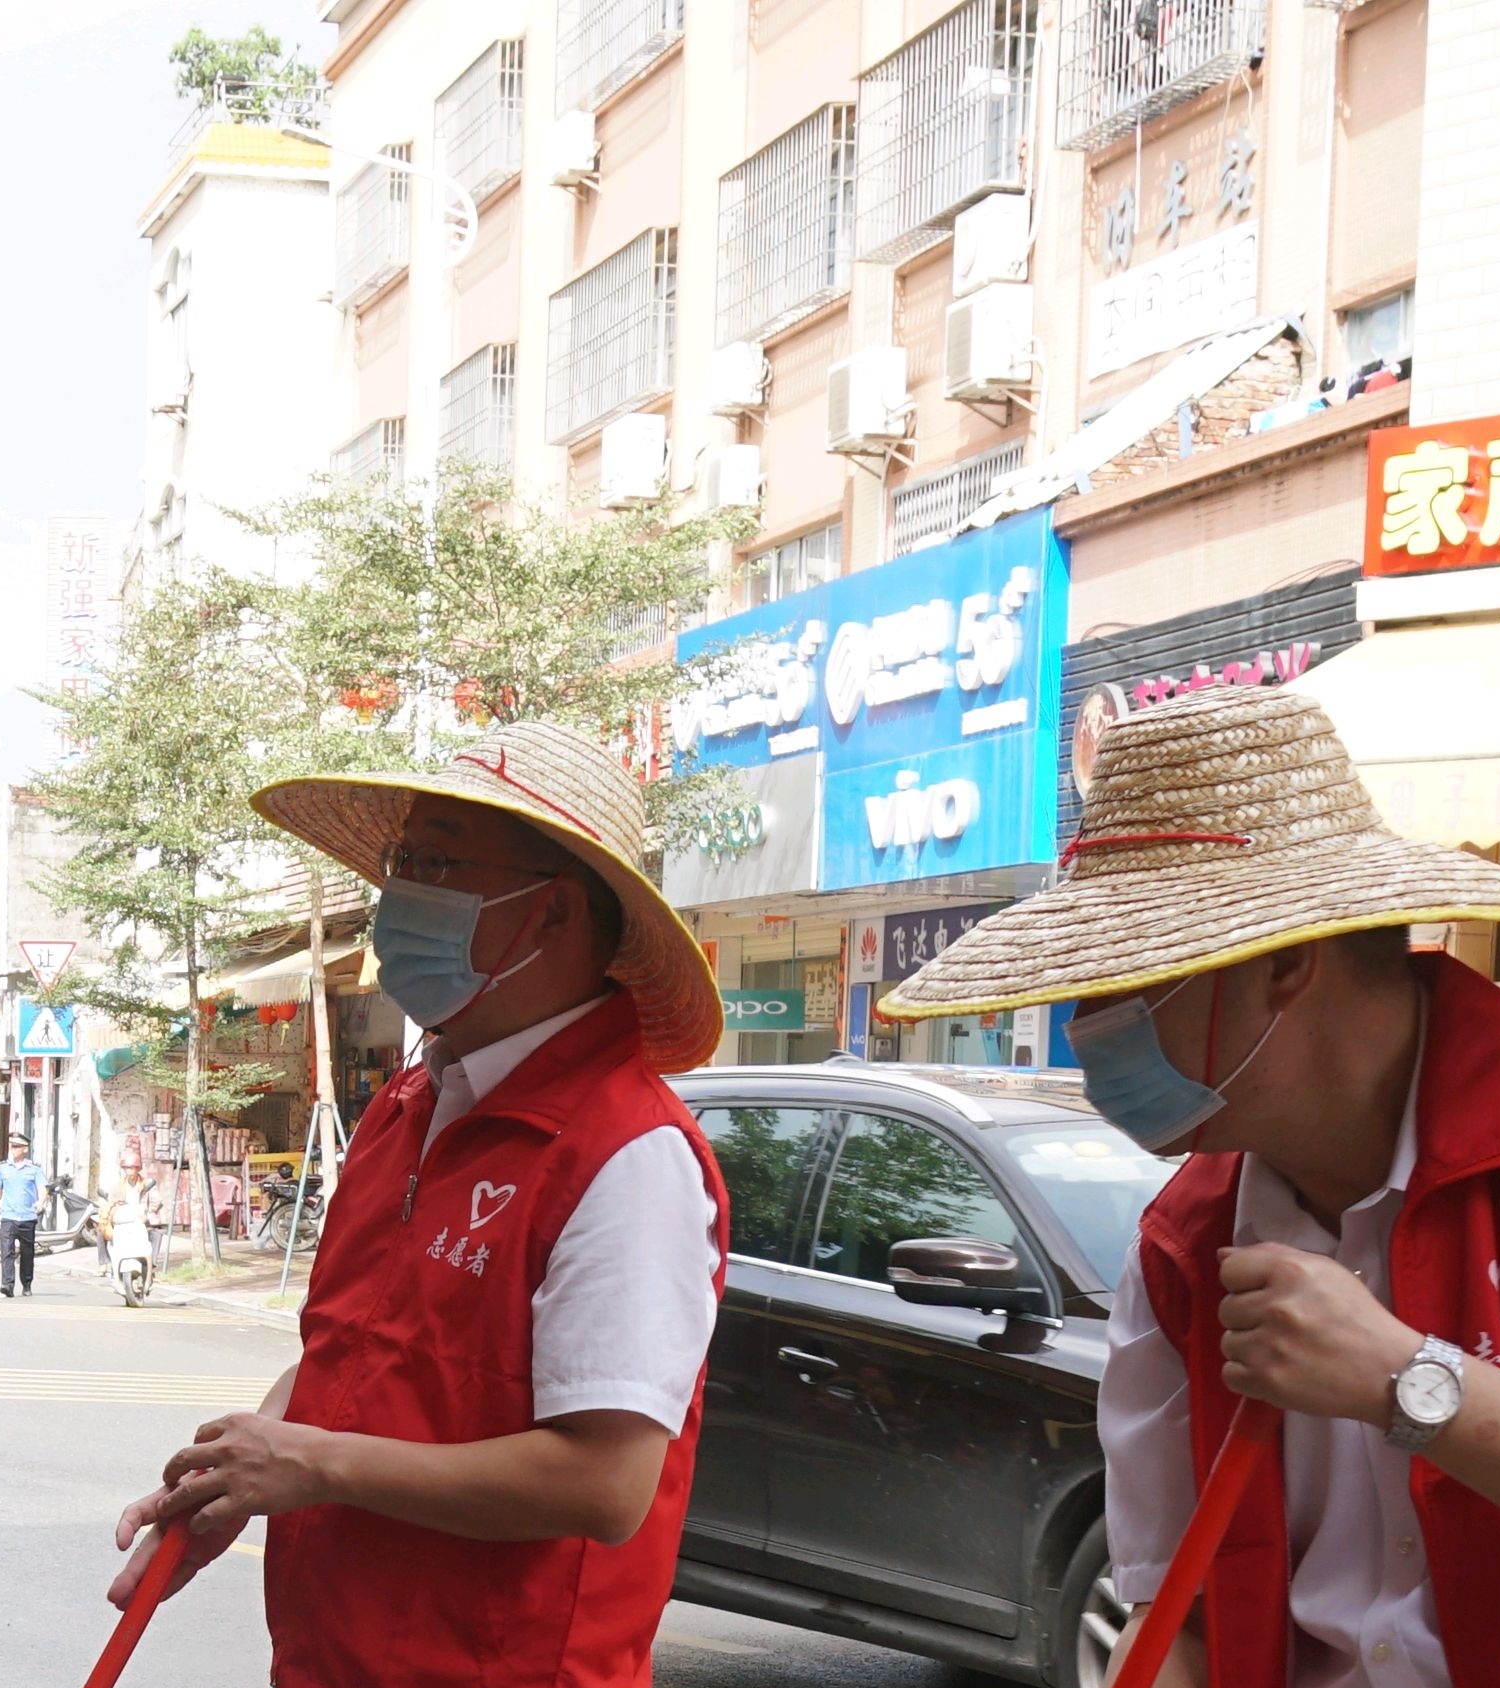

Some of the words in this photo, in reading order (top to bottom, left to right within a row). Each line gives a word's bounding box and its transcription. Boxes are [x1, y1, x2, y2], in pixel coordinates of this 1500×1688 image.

[864, 769, 980, 849] vivo
[38, 949, 56, 968] 让
[893, 916, 973, 970] 飞达电
[426, 1226, 491, 1278] 志愿者
